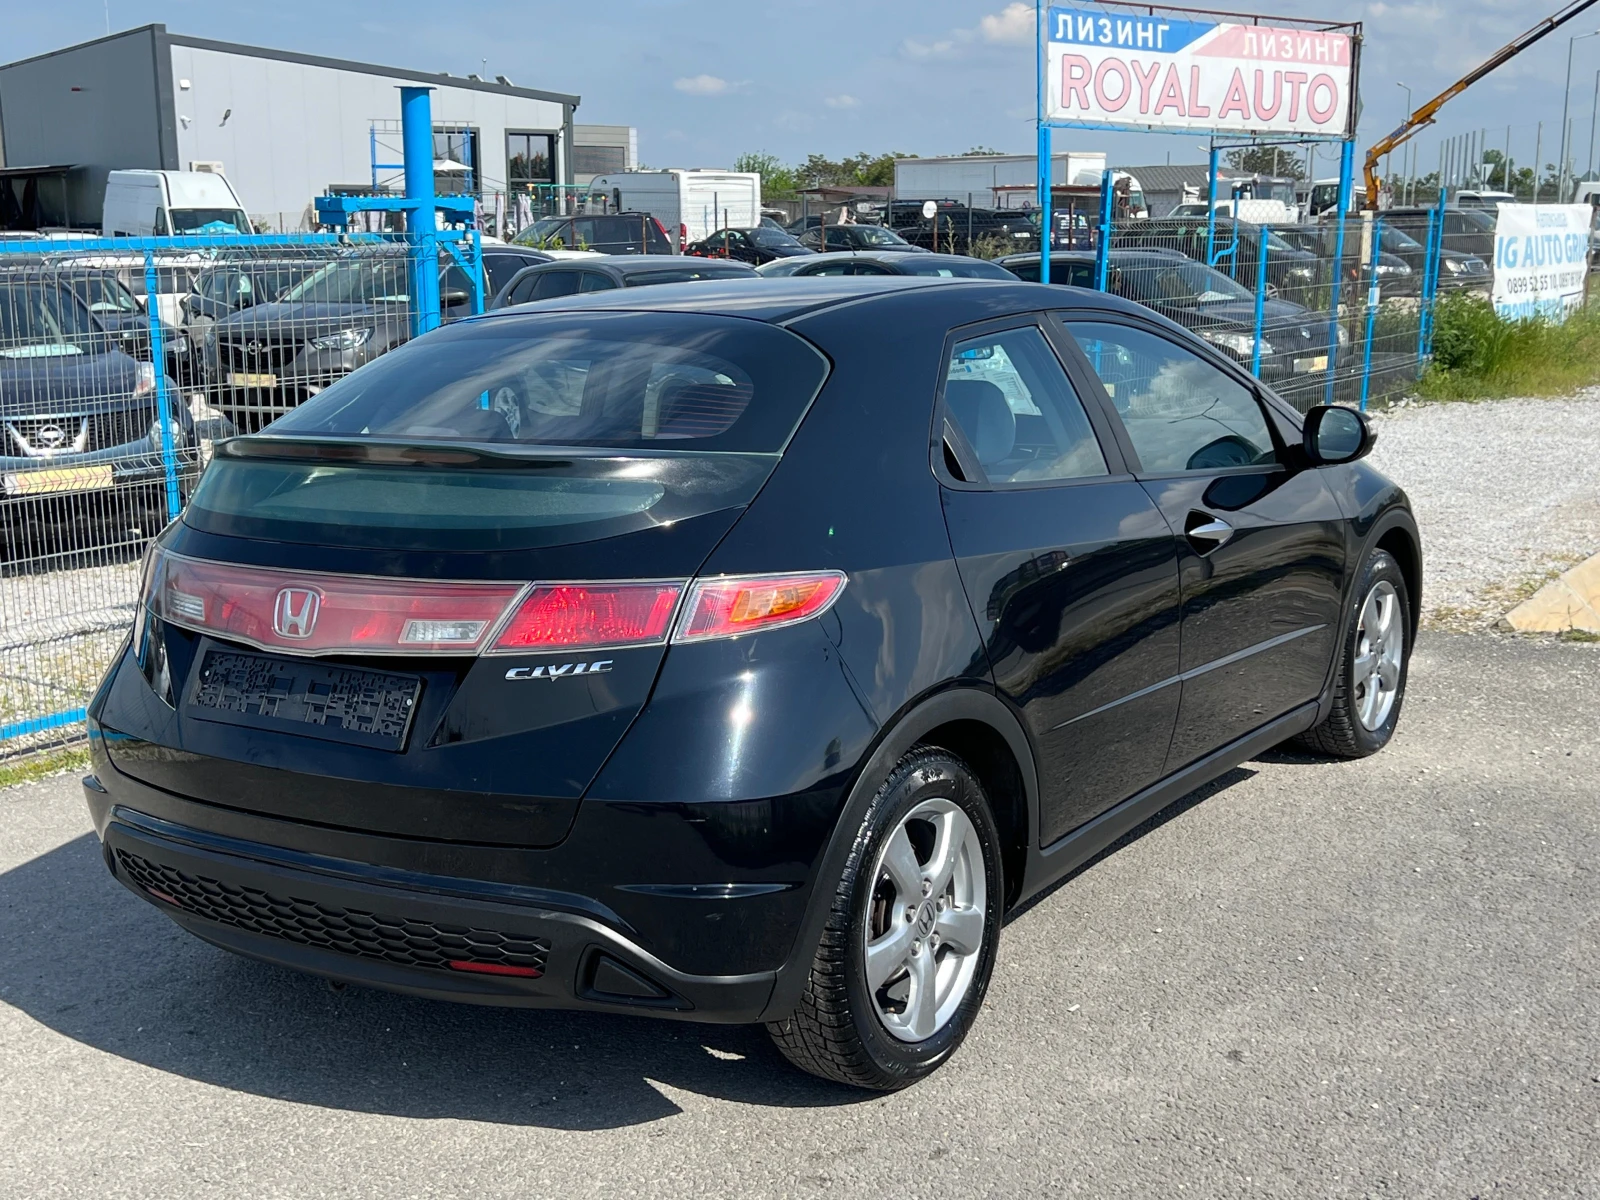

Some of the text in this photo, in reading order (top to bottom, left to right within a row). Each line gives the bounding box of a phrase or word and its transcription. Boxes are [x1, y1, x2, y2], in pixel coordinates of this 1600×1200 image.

[1055, 13, 1170, 49] ЛИЗИНГ
[1242, 32, 1344, 63] ЛИЗИНГ
[1061, 54, 1338, 124] ROYAL AUTO
[1496, 236, 1519, 269] IG
[1522, 233, 1563, 267] AUTO
[1507, 277, 1528, 294] 0899
[1529, 276, 1538, 292] 52
[1540, 275, 1548, 291] 55
[505, 660, 613, 682] CIVIC
